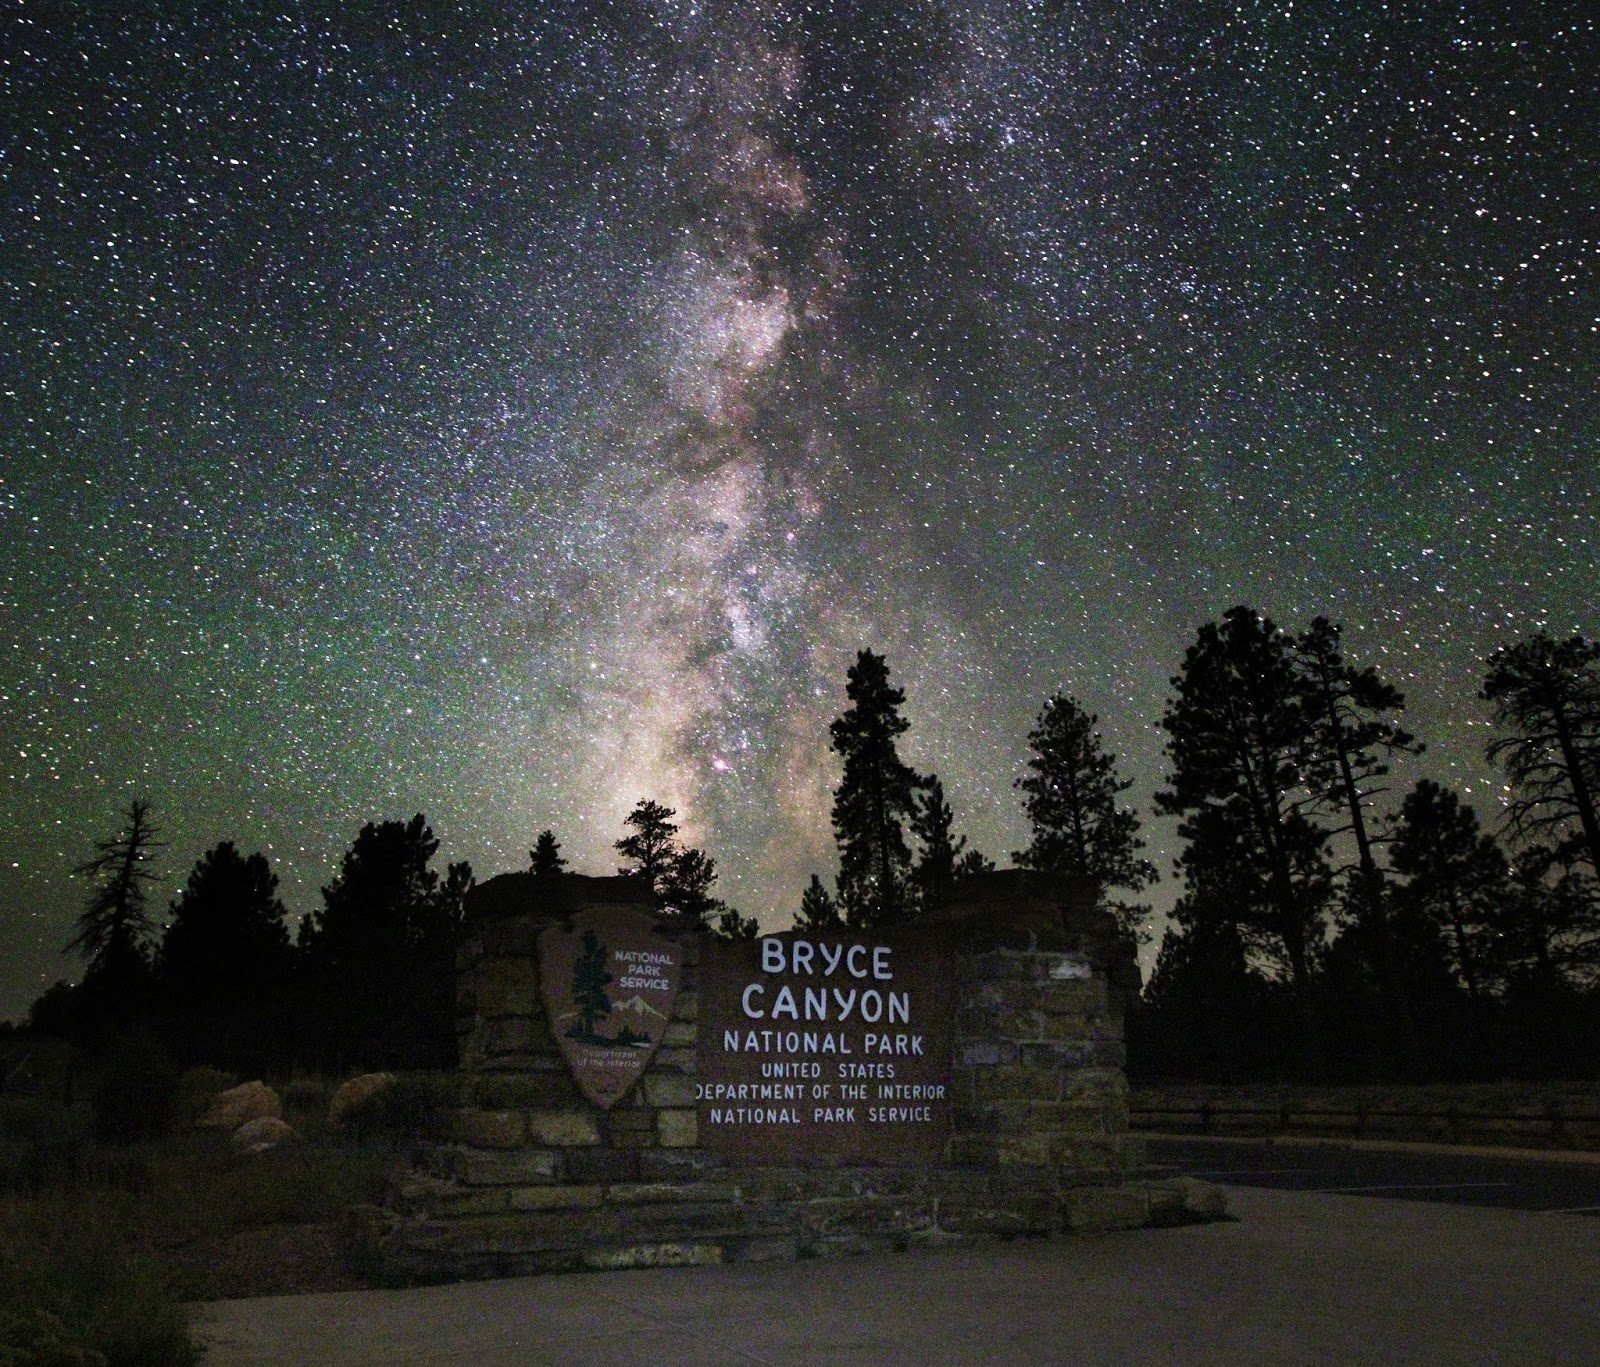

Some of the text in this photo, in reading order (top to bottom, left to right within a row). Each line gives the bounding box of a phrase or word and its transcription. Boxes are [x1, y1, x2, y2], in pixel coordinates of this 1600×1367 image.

[615, 951, 675, 965] NATIONAL
[762, 938, 893, 980] BRYCE
[629, 964, 661, 976] PARK
[620, 977, 669, 990] SERVICE
[741, 983, 909, 1024] CANYON
[724, 1030, 924, 1055] NATIONAL PARK
[762, 1062, 895, 1079] UNITED STATES
[812, 1084, 831, 1099] OF
[840, 1084, 868, 1100] THE
[879, 1084, 945, 1099] INTERIOR
[710, 1107, 932, 1123] NATIONAL PARK SERVICE
